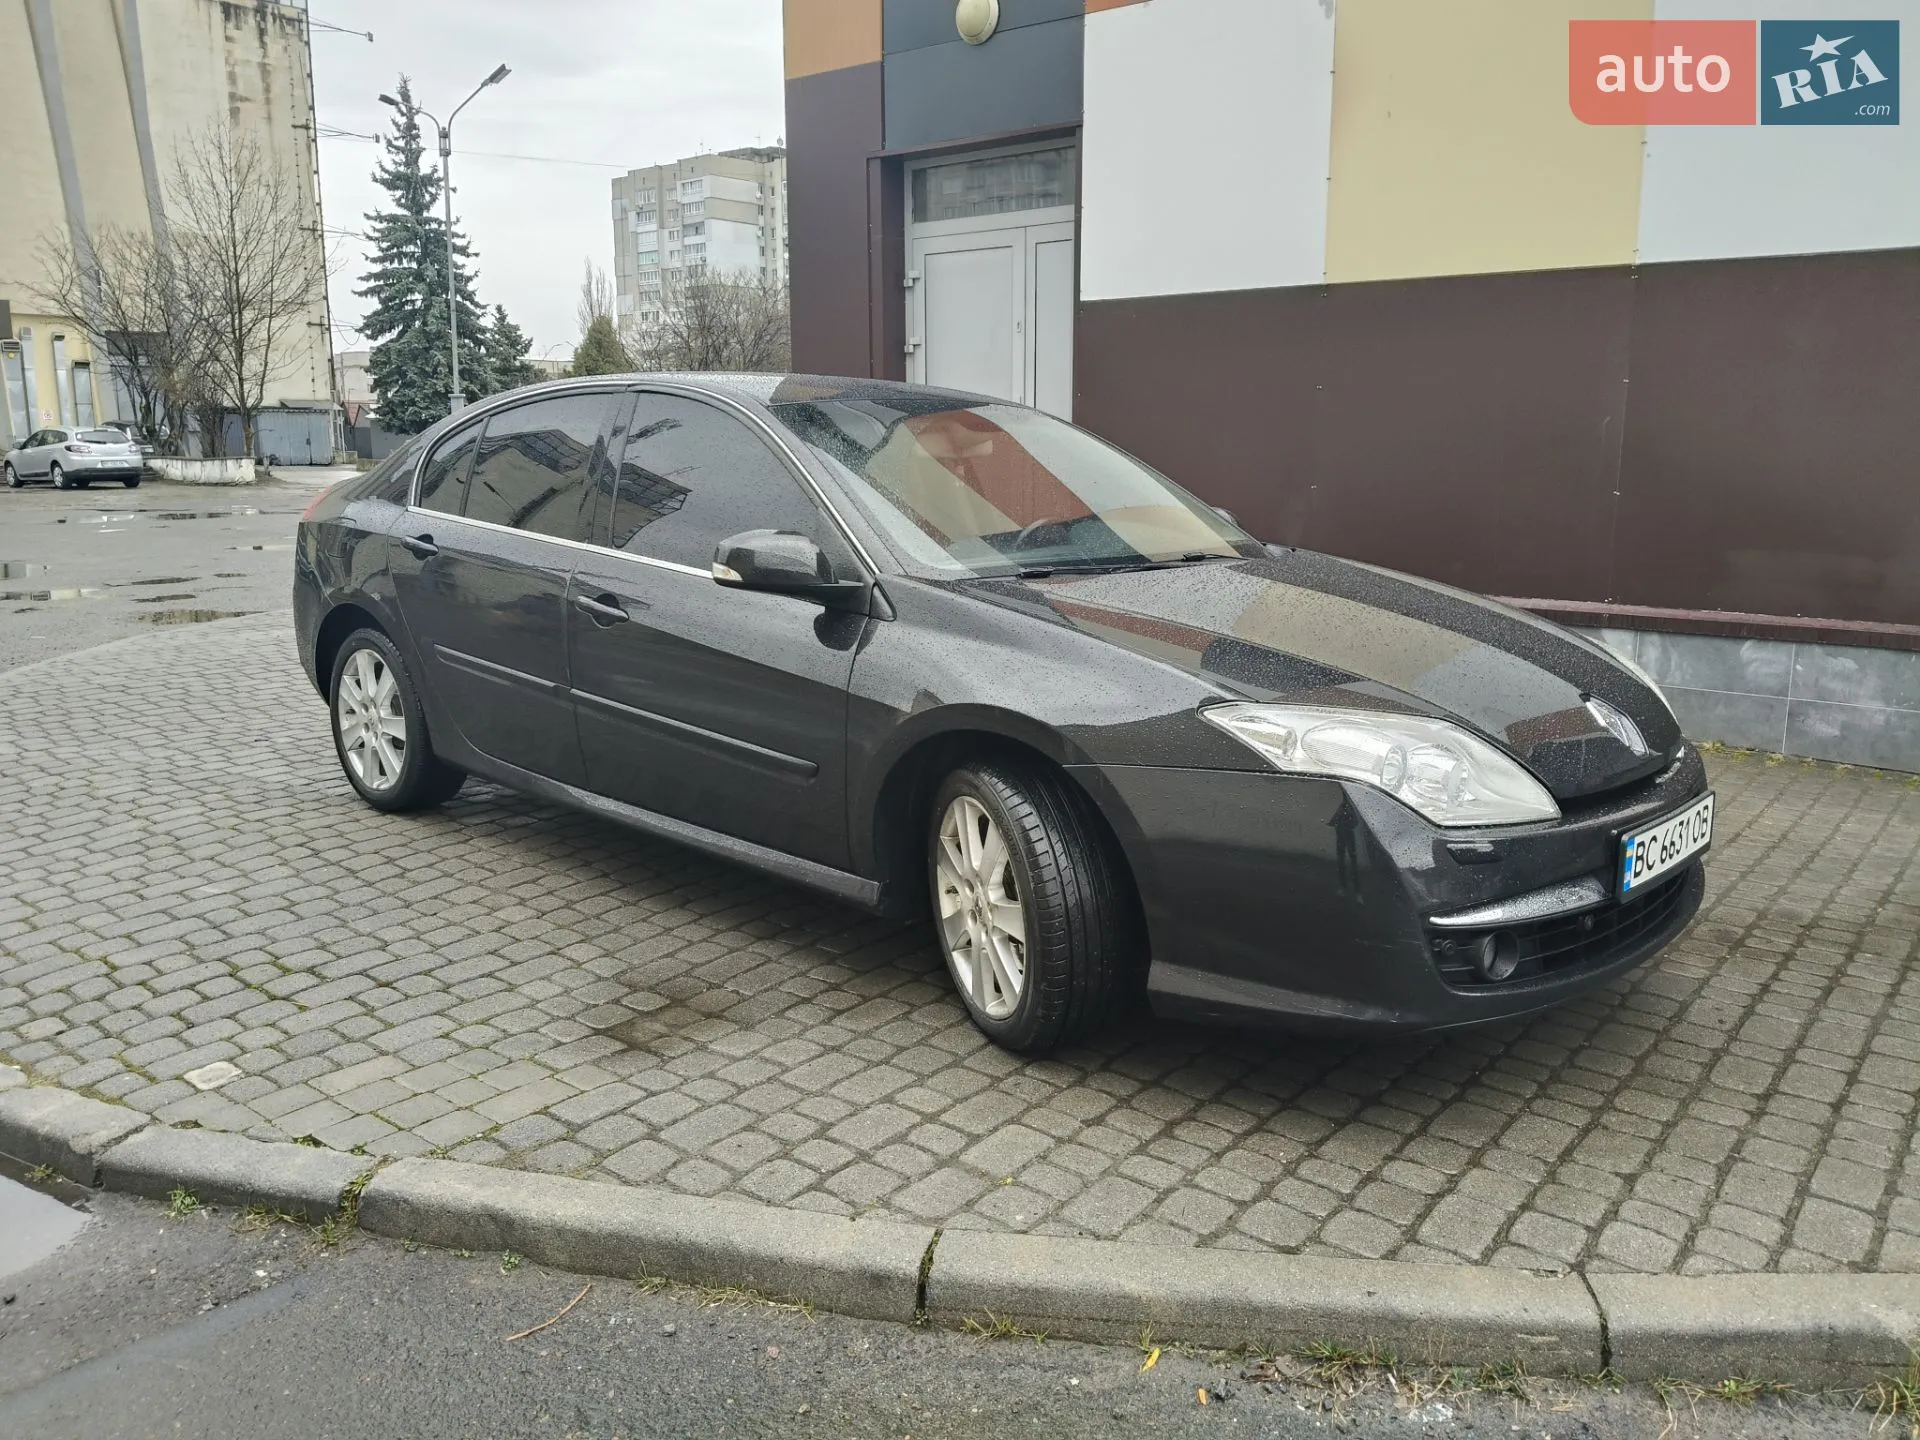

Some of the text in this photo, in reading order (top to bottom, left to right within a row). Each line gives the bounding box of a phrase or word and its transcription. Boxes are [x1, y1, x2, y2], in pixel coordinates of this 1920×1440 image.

[1633, 804, 1709, 879] BC 6631 OB
